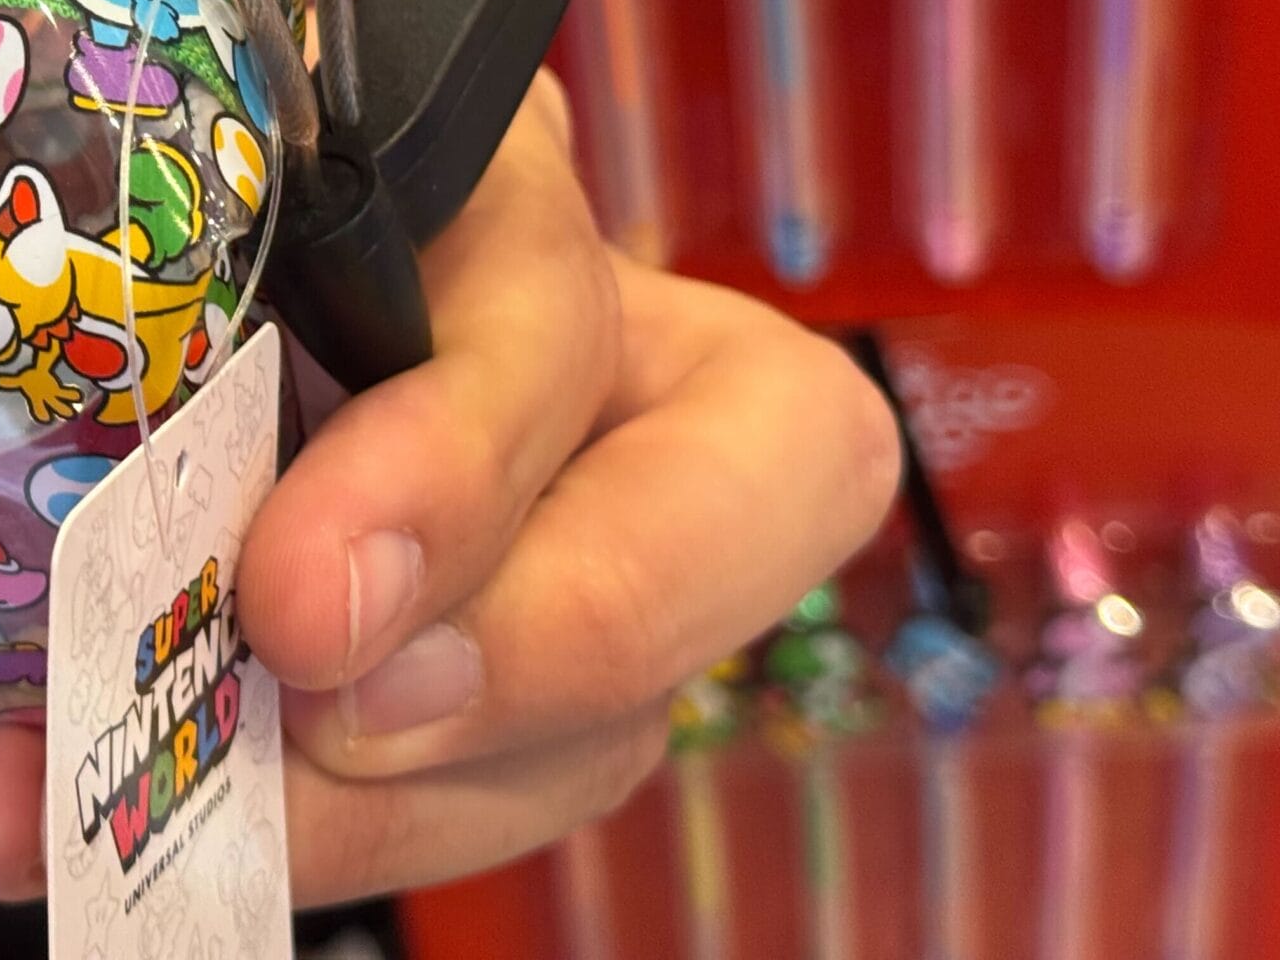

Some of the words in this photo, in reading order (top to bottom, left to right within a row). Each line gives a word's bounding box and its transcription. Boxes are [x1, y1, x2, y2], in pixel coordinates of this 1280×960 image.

[135, 555, 219, 694] SUPER
[75, 589, 250, 844] NINTEND
[110, 670, 241, 874] WORLD
[125, 834, 185, 916] UNIVERSAL
[188, 776, 232, 839] STUDIOS
